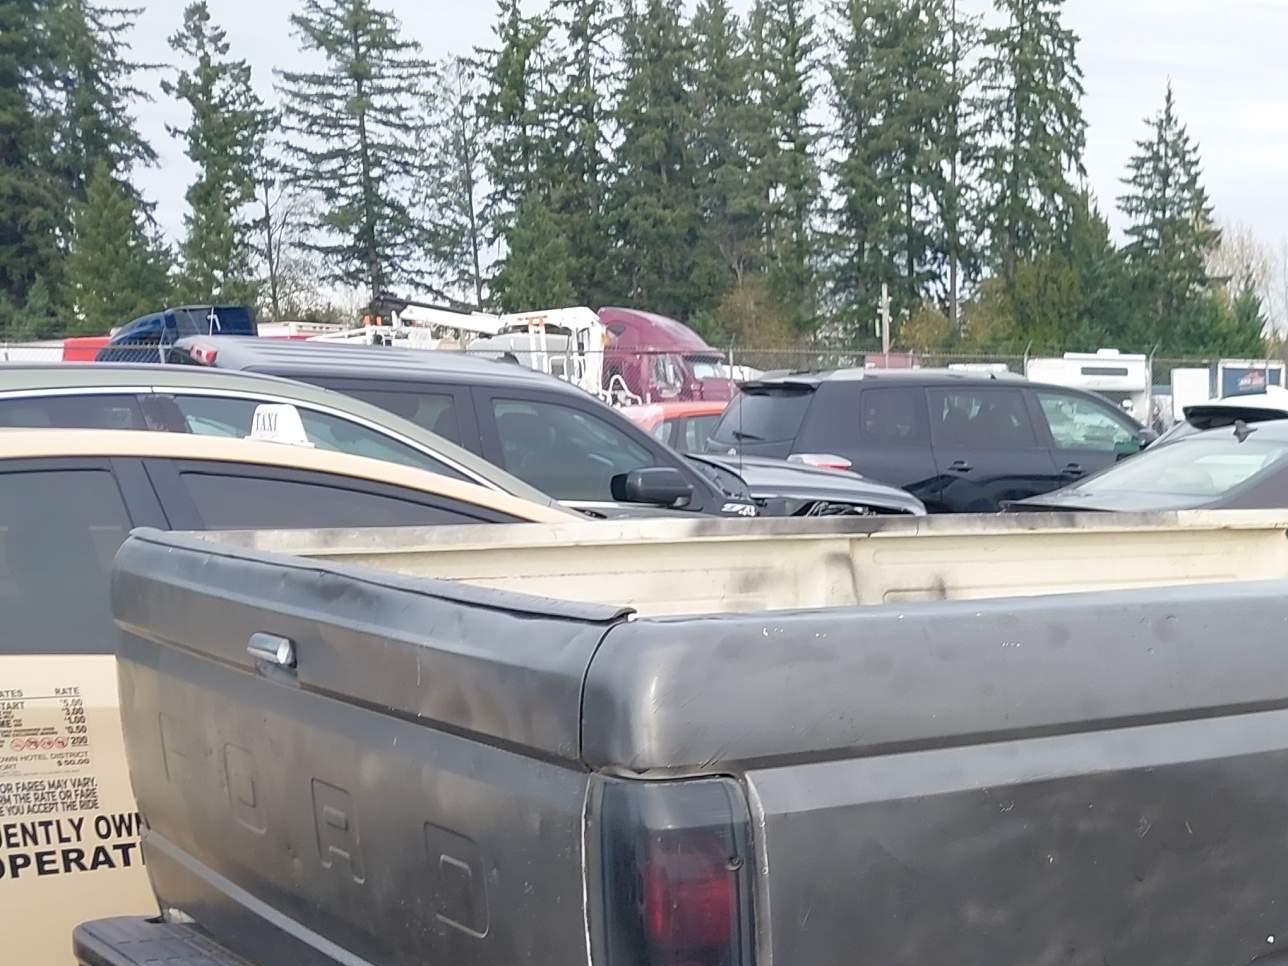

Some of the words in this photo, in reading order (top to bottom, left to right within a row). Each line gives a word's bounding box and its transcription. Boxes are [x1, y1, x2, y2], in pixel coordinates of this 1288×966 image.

[256, 412, 278, 432] TAXI
[20, 753, 48, 762] HOTEL
[50, 751, 89, 760] DISTRICT
[16, 780, 46, 792] FARES
[47, 778, 68, 790] MAY
[69, 776, 98, 788] VARY.
[13, 793, 33, 804] THE
[34, 790, 57, 802] RATE
[58, 790, 73, 801] OR
[73, 788, 98, 800] FARE
[6, 804, 25, 816] YOU
[27, 802, 59, 815] ACCEPT
[61, 800, 78, 812] THE
[79, 799, 100, 811] RIDE
[0, 817, 84, 849] ENTLY
[0, 841, 146, 880] PERAT
